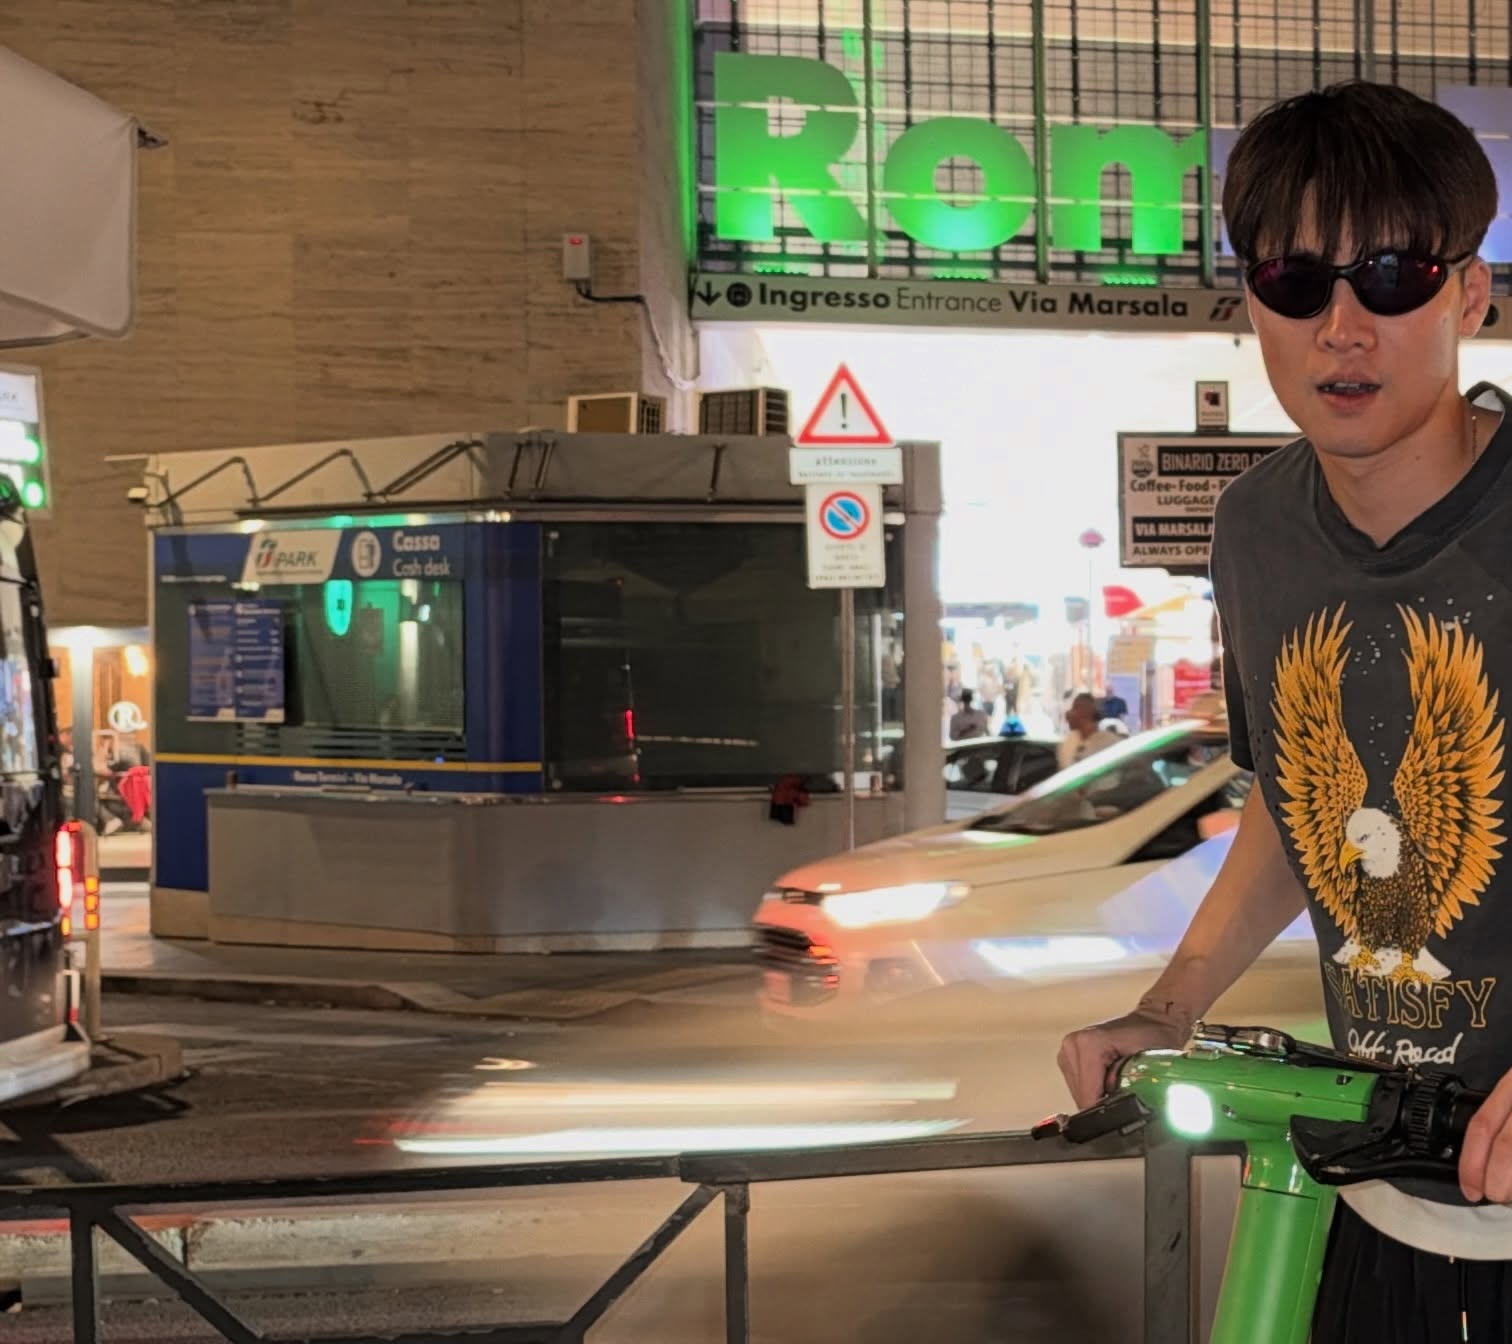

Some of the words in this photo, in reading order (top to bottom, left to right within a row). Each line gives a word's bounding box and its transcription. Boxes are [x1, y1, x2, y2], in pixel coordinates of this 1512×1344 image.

[714, 51, 1242, 256] Rom
[758, 283, 891, 312] Ingresso
[896, 287, 1001, 313] Entrance
[1008, 290, 1057, 313] Via
[1068, 292, 1188, 317] Marsala
[1161, 453, 1214, 471] BINARIO
[1216, 453, 1249, 471] ZERO
[1178, 479, 1210, 492] Food
[1157, 495, 1216, 506] LUGGAGE
[1135, 522, 1157, 537] VIA
[392, 531, 440, 551] Cassa
[1132, 545, 1182, 556] ALWAYS
[1184, 545, 1209, 556] OPE
[392, 557, 422, 577] Cash
[424, 557, 451, 577] desk
[1324, 961, 1496, 1029] SATISFY
